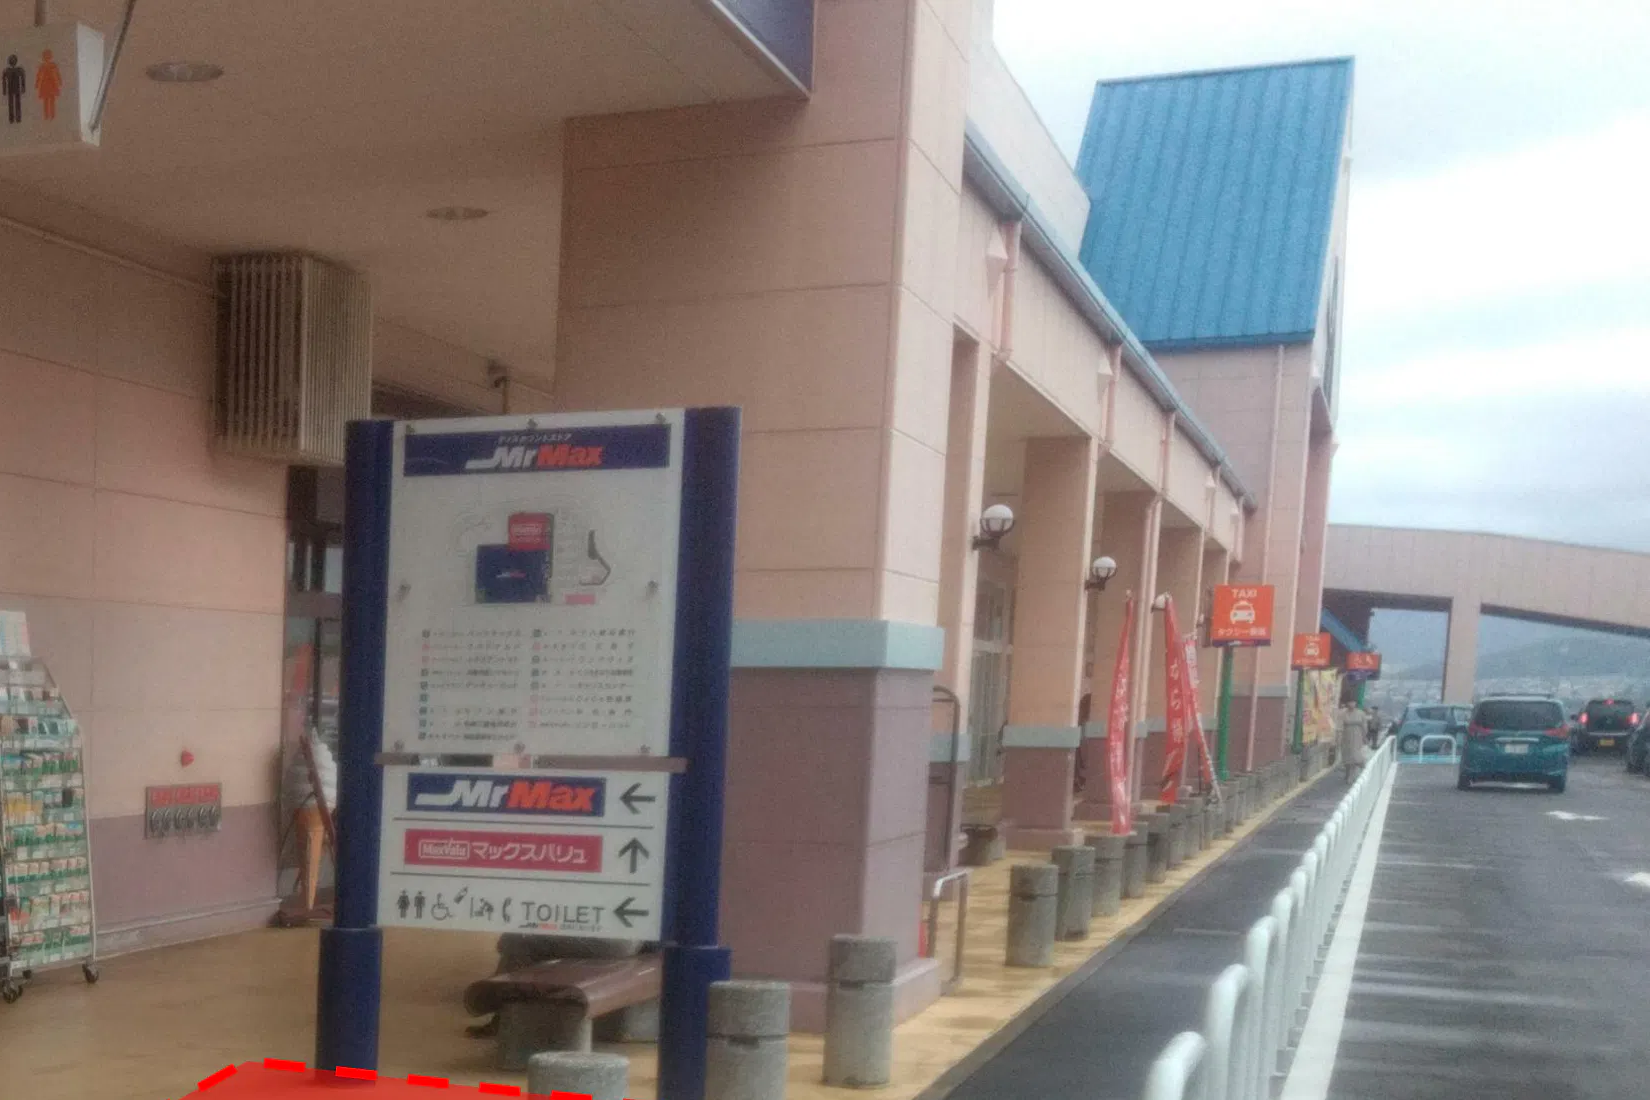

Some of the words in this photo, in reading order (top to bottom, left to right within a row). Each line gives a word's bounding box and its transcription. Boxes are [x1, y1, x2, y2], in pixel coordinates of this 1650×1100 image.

[1231, 588, 1258, 598] TAXI
[414, 779, 596, 812] MrMax
[471, 840, 588, 865] マックスバリュ
[520, 901, 605, 925] TOILET
